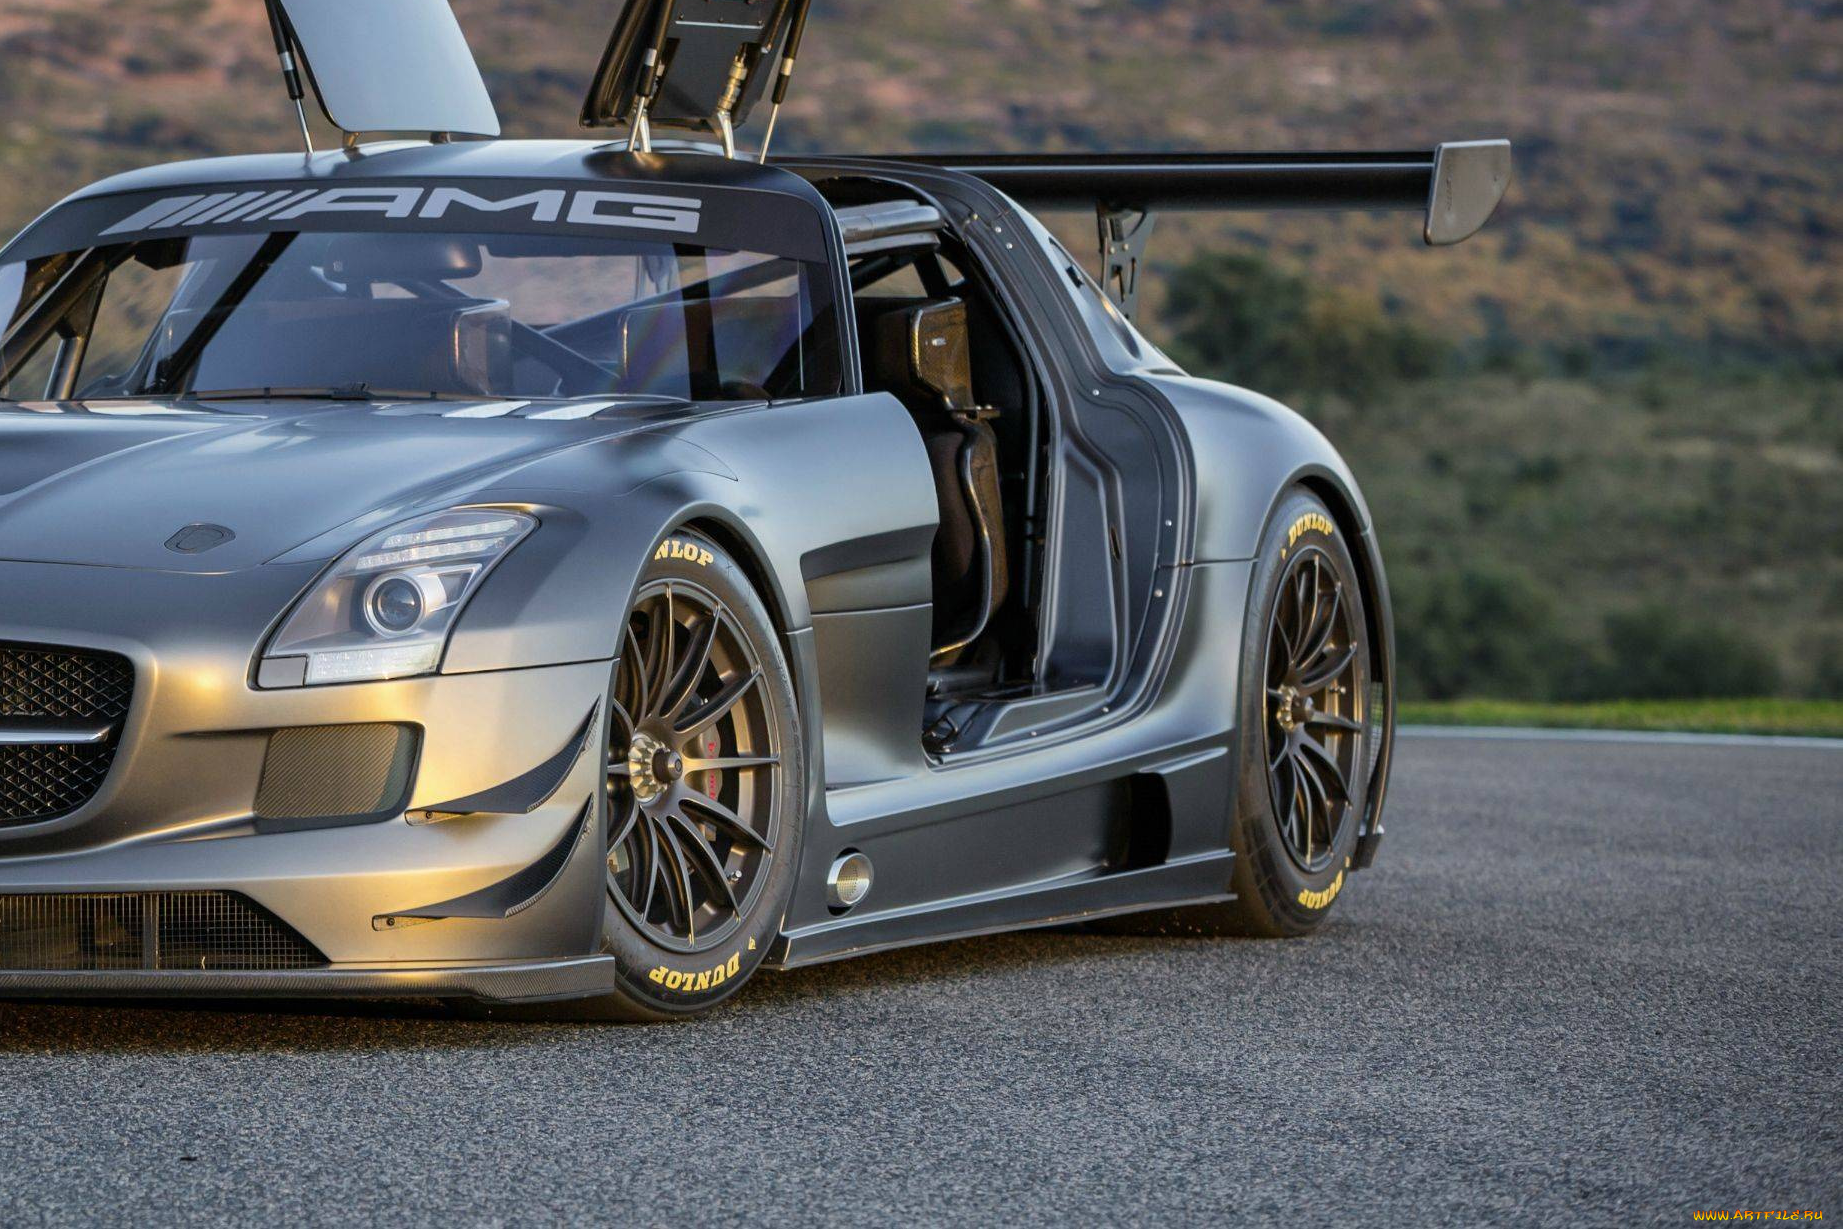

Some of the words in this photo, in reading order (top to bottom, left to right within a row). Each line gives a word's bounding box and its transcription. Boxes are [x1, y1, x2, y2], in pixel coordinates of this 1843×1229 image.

[268, 187, 702, 234] AMG
[1289, 512, 1333, 548] DUNLOP
[654, 539, 714, 566] NLOP
[1298, 869, 1343, 909] DUNLOP
[648, 951, 740, 991] DUNLOP
